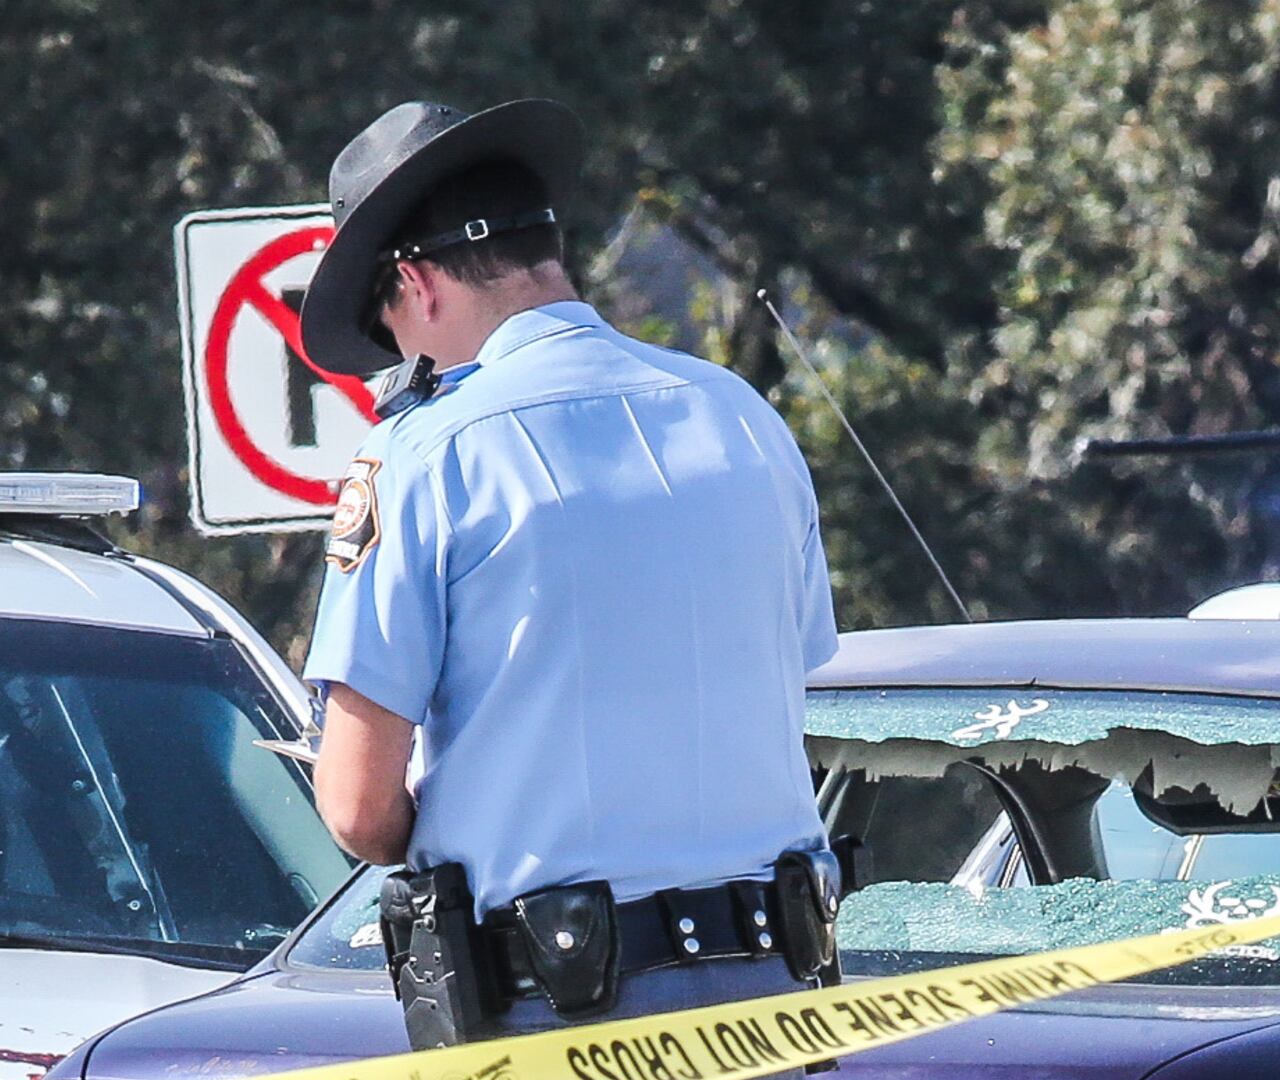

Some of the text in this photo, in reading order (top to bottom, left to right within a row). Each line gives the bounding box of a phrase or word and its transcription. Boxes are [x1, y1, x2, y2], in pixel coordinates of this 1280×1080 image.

[774, 1007, 847, 1056] DO
[835, 987, 964, 1041] SCENE
[696, 1016, 785, 1074] NOT
